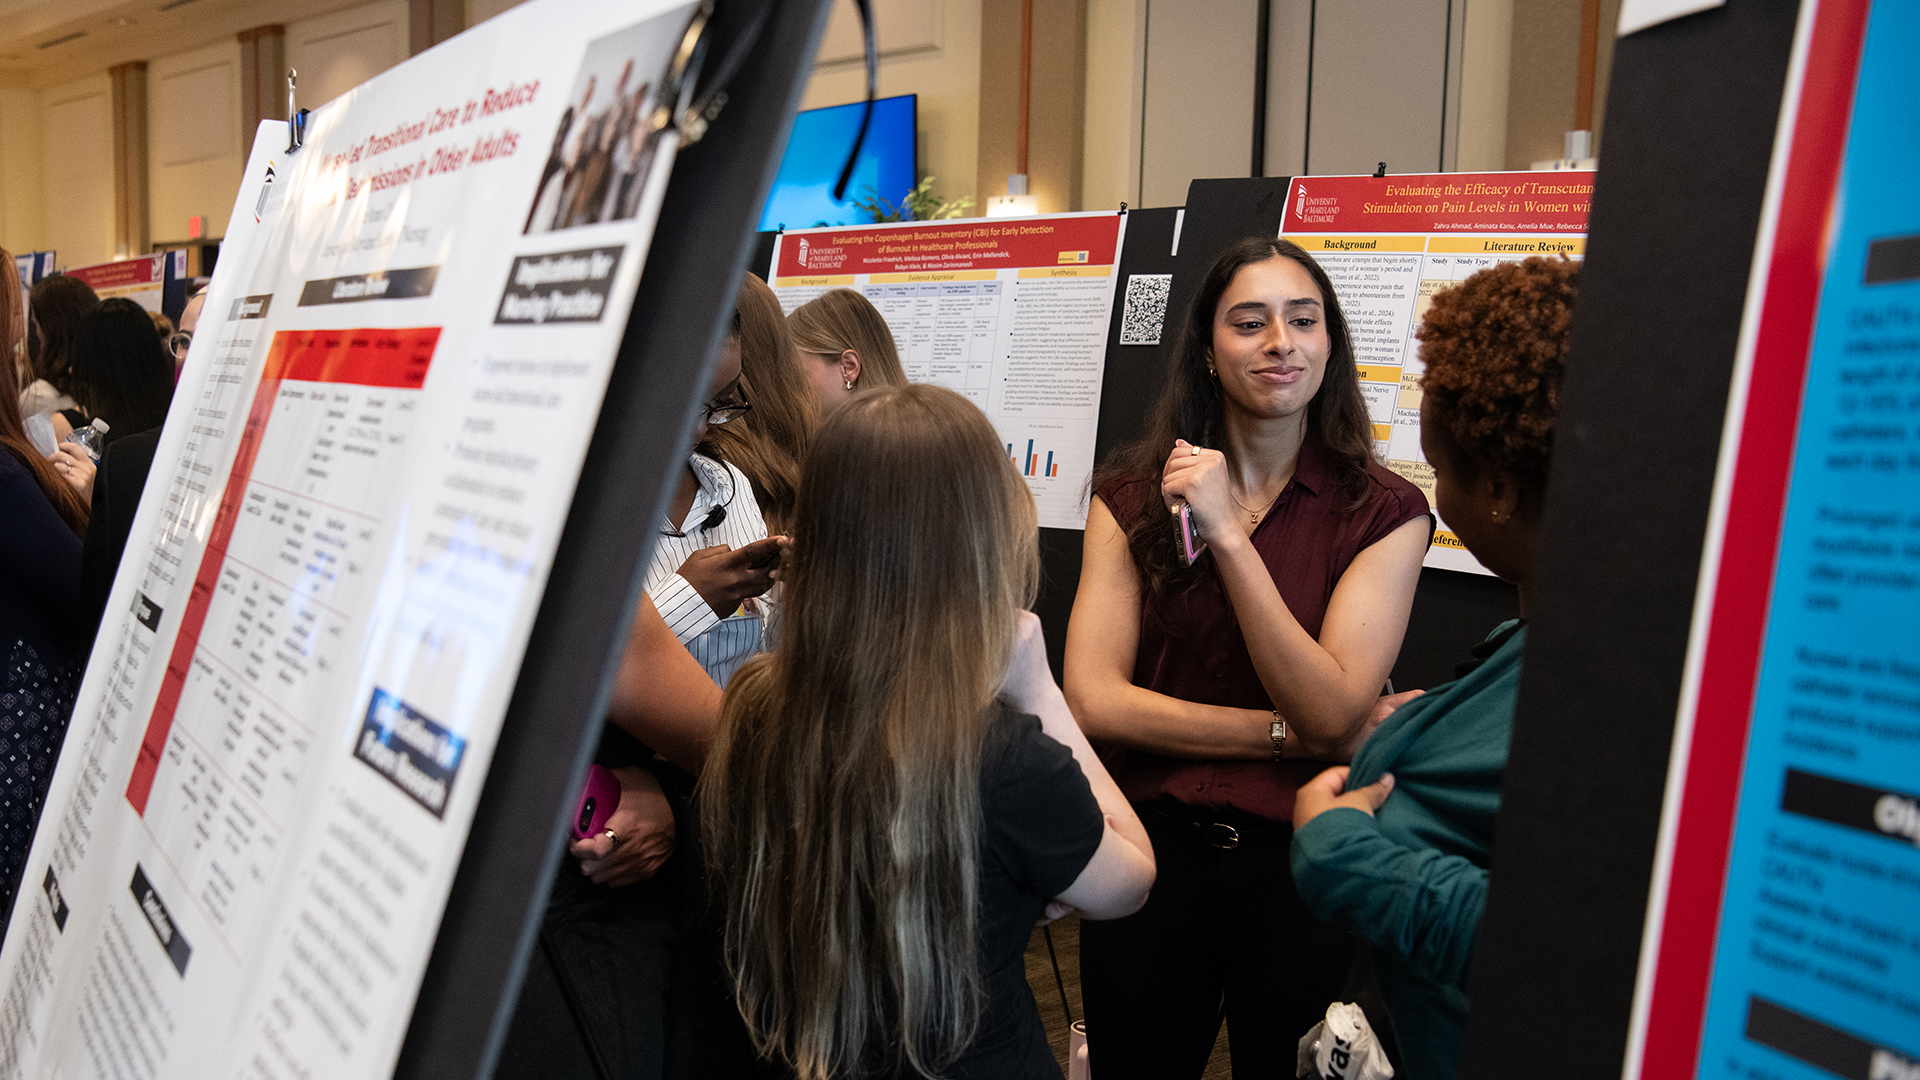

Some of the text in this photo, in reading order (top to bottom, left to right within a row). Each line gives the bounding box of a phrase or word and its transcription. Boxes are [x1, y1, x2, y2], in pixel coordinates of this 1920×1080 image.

[428, 107, 459, 136] Care
[461, 97, 477, 126] to
[479, 78, 541, 119] Reduce
[428, 141, 468, 176] Older
[469, 127, 521, 166] Adults
[1386, 184, 1442, 198] Evaluating
[1444, 184, 1461, 195] the
[1464, 183, 1511, 197] Efficacy
[1514, 183, 1529, 195] of
[1306, 198, 1338, 206] UNIVERSITY
[1309, 206, 1339, 214] MARYLAND
[1363, 202, 1422, 214] Stimulation
[1425, 204, 1438, 213] on
[1441, 202, 1465, 213] Pain
[1468, 201, 1505, 213] Levels
[1509, 201, 1519, 213] in
[1524, 201, 1569, 213] Women
[1303, 214, 1335, 223] BALTIMORE
[832, 225, 1054, 245] Evaluating the Copenhagen Burnout Inventory (CBI) for Early Detection
[886, 244, 911, 253] Burnout
[912, 244, 919, 252] in
[920, 242, 954, 252] Healthcare
[955, 240, 998, 250] Professionals
[1324, 240, 1376, 251] Background
[1484, 241, 1575, 252] Literature Review
[809, 247, 843, 255] UNIVERSITY
[814, 254, 847, 262] MARYLAND
[1399, 257, 1418, 265] shortly
[1475, 258, 1489, 266] Type
[807, 261, 842, 269] BALTIMORE
[931, 273, 954, 282] Appraisal
[1050, 269, 1077, 277] Synthesis
[1434, 535, 1464, 547] eferen
